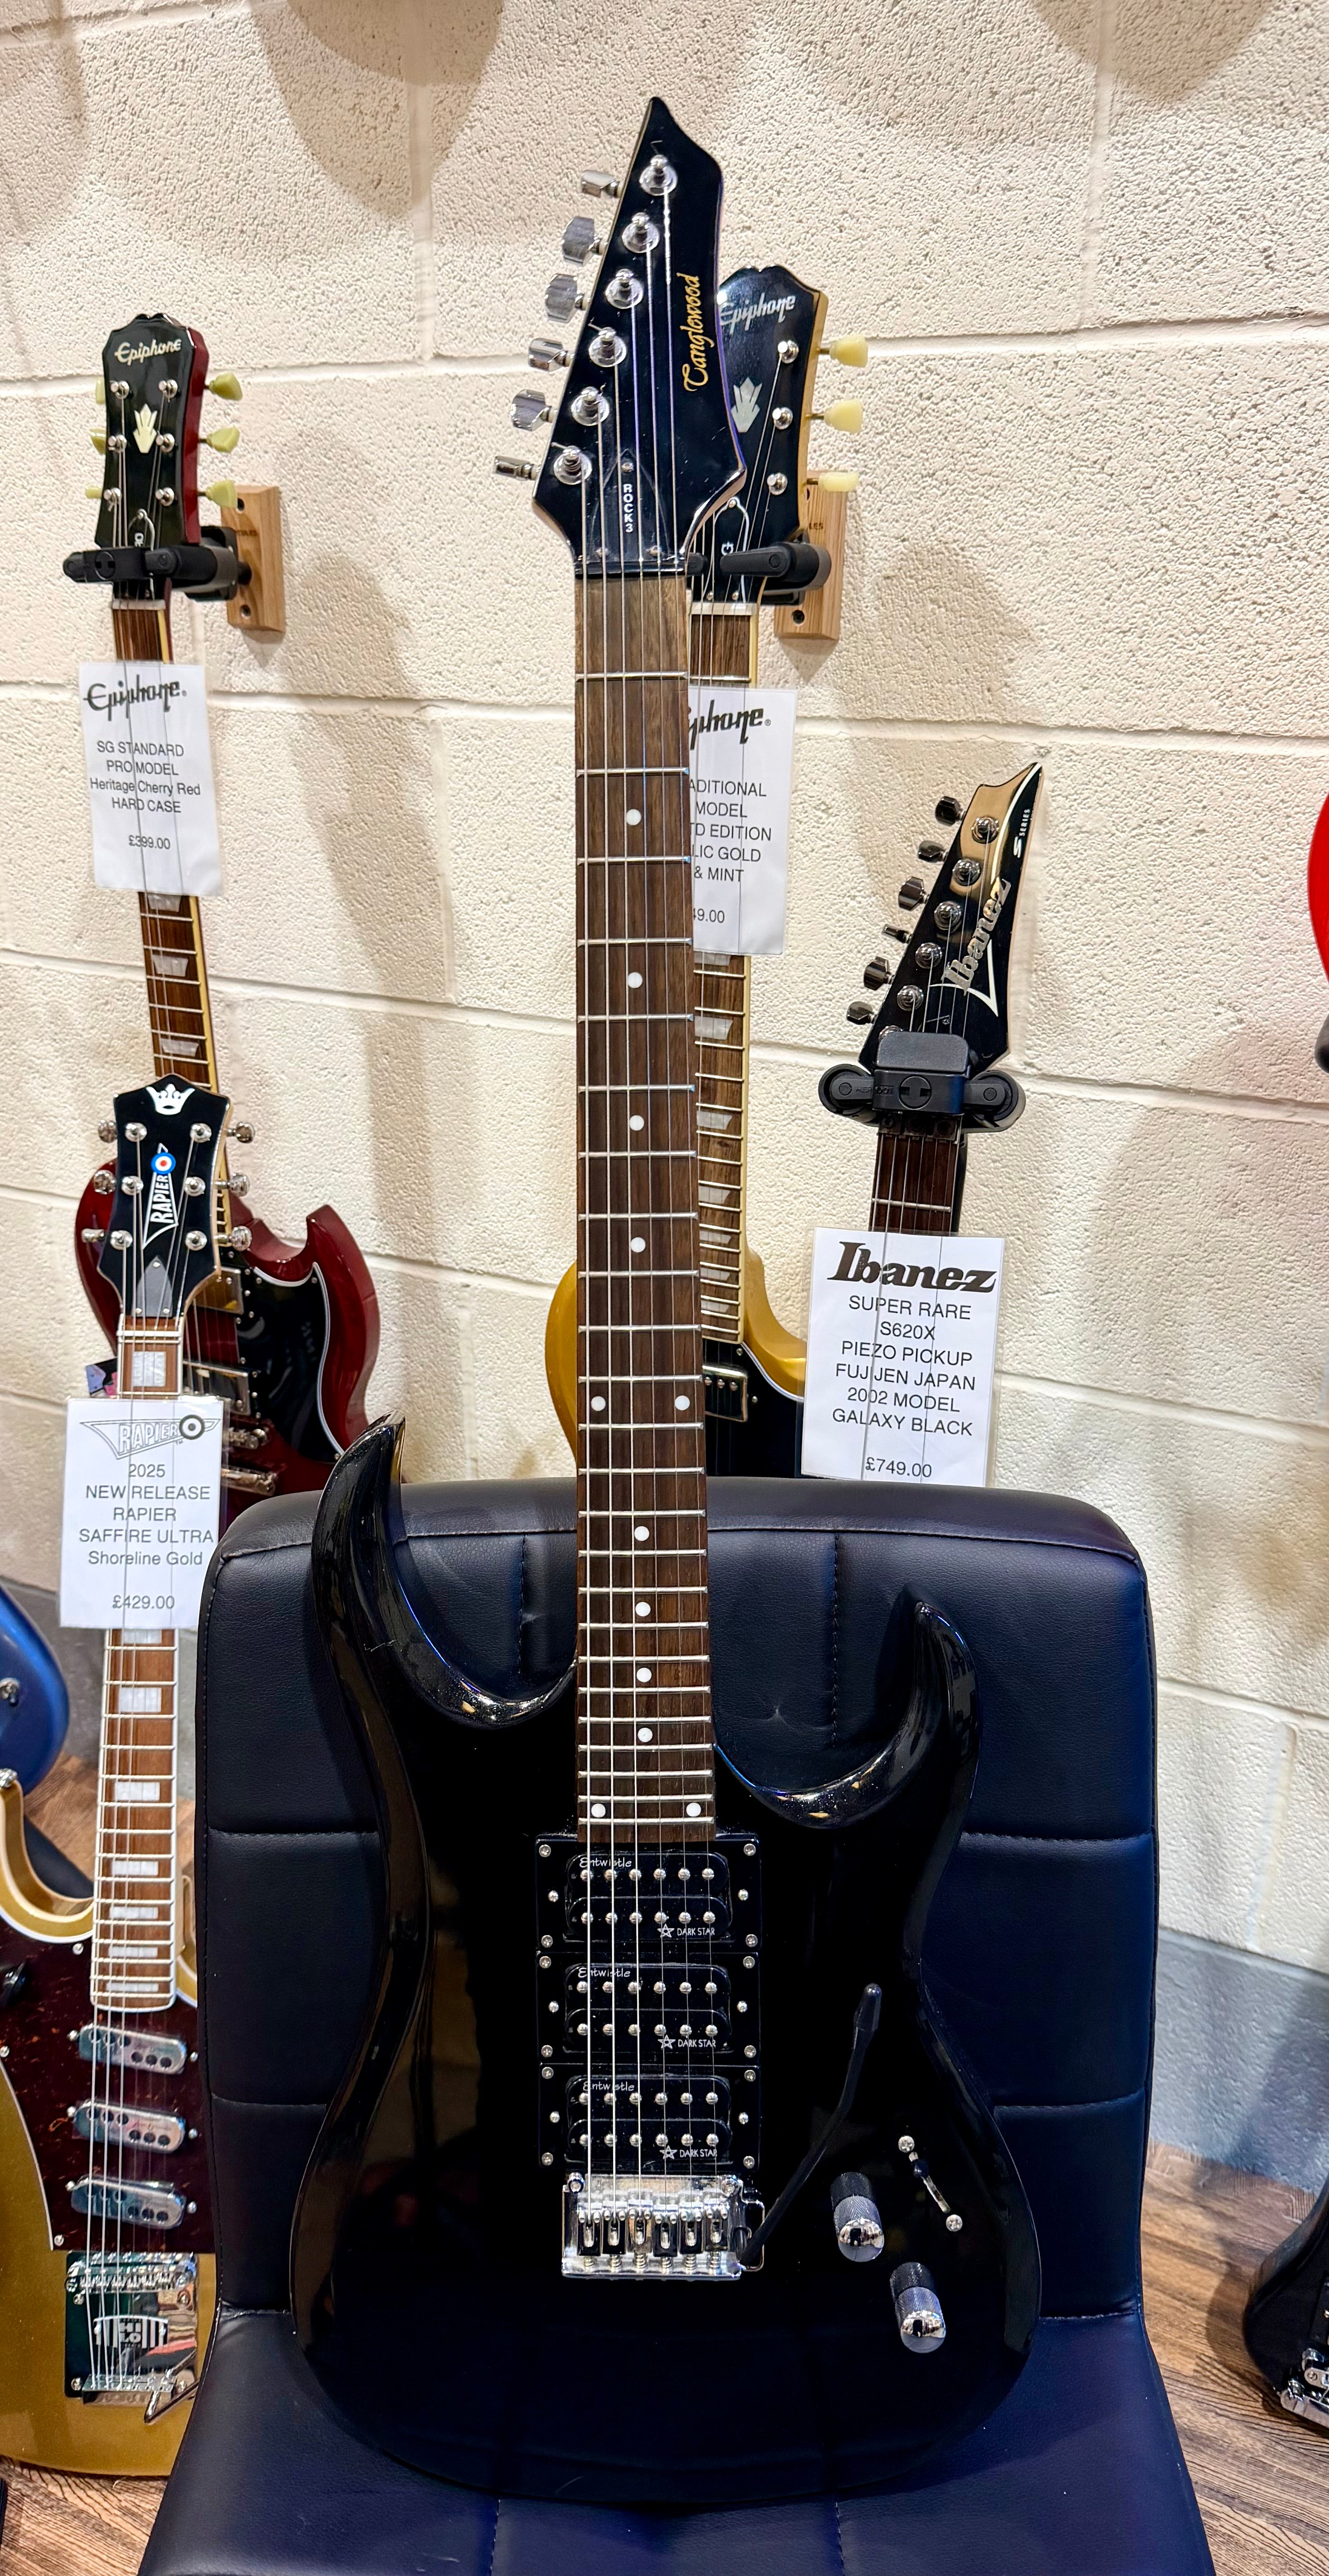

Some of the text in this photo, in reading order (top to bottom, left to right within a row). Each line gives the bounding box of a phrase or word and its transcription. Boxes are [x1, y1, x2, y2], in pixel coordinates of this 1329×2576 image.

[720, 293, 796, 336] Epiphone
[676, 272, 715, 391] Tanglewood
[114, 339, 182, 366] Epiphone
[84, 674, 180, 722] Epiphone
[97, 741, 184, 757] SG STANDARD
[106, 760, 179, 776] PRO MODEL
[90, 778, 201, 797] Heritage Cherry Red
[689, 779, 767, 797] ADITIONAL
[112, 797, 182, 813] HARD CASE
[696, 801, 748, 818] MODEL
[710, 823, 772, 841] EDITION
[1019, 809, 1031, 837] SERIES
[128, 835, 171, 850] £399.00
[718, 846, 761, 862] GOLD
[694, 865, 745, 882] & MINT
[941, 877, 1011, 996] Ibanez
[150, 1175, 174, 1224] RAPIER
[827, 1241, 997, 1293] Ibanez
[849, 1295, 972, 1320] SUPER RARE
[880, 1321, 936, 1340] S620X
[842, 1340, 972, 1366] PIEZO PICKUP
[914, 1372, 976, 1391] JAPAN
[847, 1387, 960, 1412] 2002 MODEL
[833, 1408, 973, 1436] GALAXY BLACK
[119, 1422, 180, 1453] RAPIER
[129, 1463, 166, 1478] 2025
[865, 1457, 932, 1477] £749.00
[86, 1485, 211, 1500] NEW RELEASE
[113, 1507, 177, 1521] RAPIER
[79, 1528, 214, 1543] SAFFIRE ULTRA
[88, 1550, 203, 1565] Shoreline Gold
[112, 1595, 175, 1610] £429.00
[579, 1857, 632, 1868] Entwistle
[677, 1927, 715, 1936] DARK STAR
[678, 2039, 716, 2048] DARK STAR
[582, 2081, 635, 2092] Entwstle
[679, 2148, 717, 2158] DARK STAR
